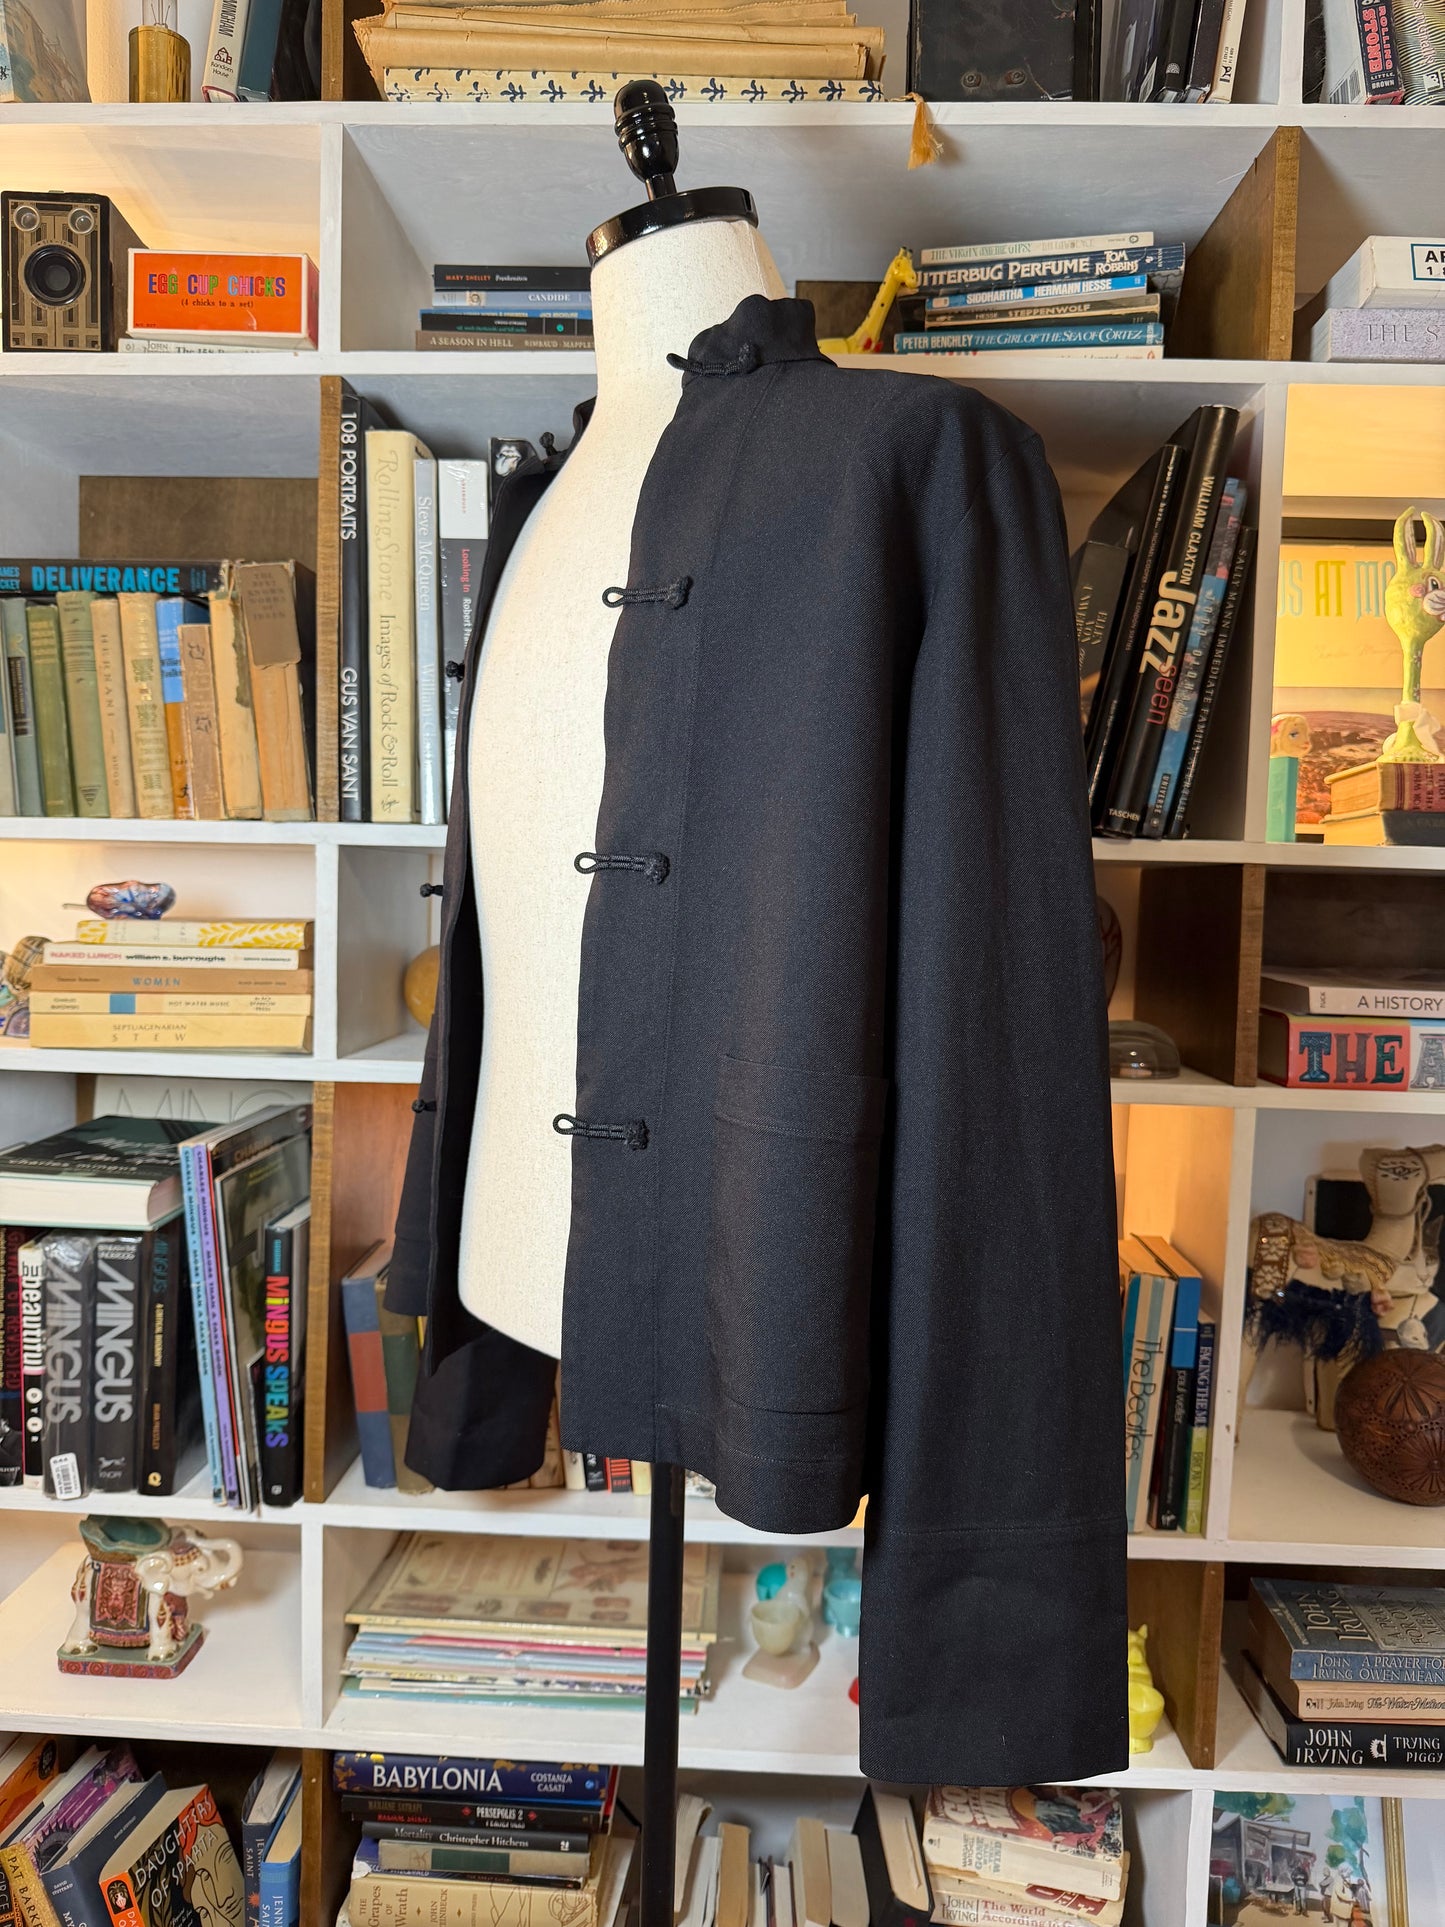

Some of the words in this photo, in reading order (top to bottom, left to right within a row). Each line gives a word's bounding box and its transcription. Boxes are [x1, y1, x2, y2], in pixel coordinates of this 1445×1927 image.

[1362, 8, 1383, 73] STONE
[1378, 5, 1393, 70] ROLLING
[211, 61, 234, 73] Random
[212, 68, 230, 78] House
[1371, 80, 1395, 90] BROWN
[1007, 256, 1090, 280] PERFUME
[1095, 260, 1139, 276] ROBBINS
[1103, 249, 1129, 263] TOM
[148, 273, 179, 294] EGG
[187, 274, 219, 295] CUP
[228, 275, 286, 298] CHICKS
[528, 294, 571, 302] CANDIDE
[966, 287, 1024, 305] SIDDHARTHA
[1033, 281, 1081, 298] HERMANN
[1081, 279, 1113, 293] HESSE
[192, 298, 215, 307] chicks
[218, 299, 227, 307] to
[1007, 303, 1091, 317] STEPPENWOLF
[438, 337, 475, 347] SEASON
[476, 338, 488, 347] IN
[489, 338, 514, 348] HELL
[562, 341, 595, 349] MAPPLE
[902, 336, 929, 350] PETER
[930, 333, 974, 348] BENCHLEY
[974, 335, 997, 345] THE
[996, 333, 1024, 345] GIRL
[1040, 332, 1062, 343] THE
[1098, 327, 1143, 343] CORTEZ
[1362, 323, 1415, 342] THE
[340, 412, 357, 444] 108
[340, 449, 357, 541] PORTRAITS
[375, 450, 399, 535] Rolling
[1192, 476, 1215, 529] WILLIAM
[417, 495, 433, 537] Steve
[0, 566, 20, 578] AMES
[376, 535, 400, 601] Stone
[460, 548, 472, 582] Looking
[1179, 531, 1203, 586] CLAXTON
[1231, 550, 1249, 591] SALLY
[31, 565, 181, 593] DELIVERANCE
[417, 540, 433, 612] McQueen
[1314, 560, 1346, 617] AT
[462, 597, 473, 627] Robert
[1139, 570, 1198, 675] Jazz
[1222, 591, 1240, 633] MANN
[376, 615, 396, 669] Images
[101, 634, 115, 717] HERNANI
[376, 673, 398, 691] of
[1203, 634, 1230, 704] IMMEDIATE
[341, 666, 358, 707] GUS
[1145, 662, 1177, 726] seen
[381, 692, 397, 731] Rock
[341, 710, 359, 749] VAN
[341, 752, 359, 801] SANT
[382, 756, 398, 788] Roll
[1153, 774, 1170, 815] UNIVERSE
[1109, 807, 1141, 822] TASCHEN
[132, 977, 181, 987] WOMEN
[1357, 995, 1370, 1009] A
[1374, 996, 1444, 1011] HISTORY
[1298, 1031, 1405, 1084] THE
[184, 1150, 193, 1192] CHARLES
[197, 1151, 205, 1193] CHARLES
[201, 1196, 209, 1236] MINGUS
[188, 1196, 196, 1236] MINGUS
[22, 1276, 42, 1370] beautiful
[6, 1315, 21, 1390] REVISITED
[45, 1258, 83, 1424] MINGUS
[94, 1256, 135, 1424] MINGUS
[1132, 1336, 1164, 1377] The
[1198, 1346, 1213, 1386] FACING
[1176, 1370, 1188, 1394] paul
[1174, 1394, 1187, 1425] weller
[1196, 1387, 1211, 1410] THE
[1126, 1381, 1156, 1461] Beatles
[1312, 1662, 1354, 1680] IRVING
[1319, 1653, 1351, 1667] JOHN
[1361, 1656, 1371, 1667] A
[1374, 1656, 1421, 1670] PRAYER
[1359, 1668, 1401, 1682] OWEN
[1404, 1669, 1445, 1684] MEAN
[1304, 1728, 1352, 1748] JOHN
[1392, 1736, 1441, 1750] TRYING
[1295, 1747, 1364, 1765] IRVING
[1406, 1751, 1443, 1764] PIGGY
[372, 1765, 504, 1792] BABYLONIA
[530, 1772, 573, 1784] COSTANZA
[537, 1783, 566, 1793] CASATI
[476, 1806, 517, 1820] PERSEPOLIS
[517, 1809, 524, 1820] 2
[135, 1795, 213, 1888] DAUGHTERS
[394, 1827, 433, 1840] Mortality
[439, 1833, 490, 1846] Christopher
[490, 1836, 529, 1848] Hitchens
[975, 1836, 984, 1870] GONE
[151, 1878, 170, 1908] OF
[171, 1827, 218, 1886] SPARTA
[246, 1847, 254, 1878] SAINT
[993, 1840, 1002, 1873] WIND
[7, 1855, 24, 1880] PAT
[19, 1885, 44, 1927] BARKE
[53, 1880, 68, 1890] DAVID
[359, 1898, 367, 1916] THE
[367, 1885, 382, 1927] Grapes
[386, 1903, 393, 1916] OF
[395, 1887, 408, 1927] Wrath
[430, 1900, 439, 1924] JOHN
[941, 1904, 976, 1923] IRVING
[945, 1895, 974, 1910] JOHN
[981, 1899, 1008, 1913] The
[1009, 1902, 1046, 1917] World
[981, 1910, 1045, 1927] According
